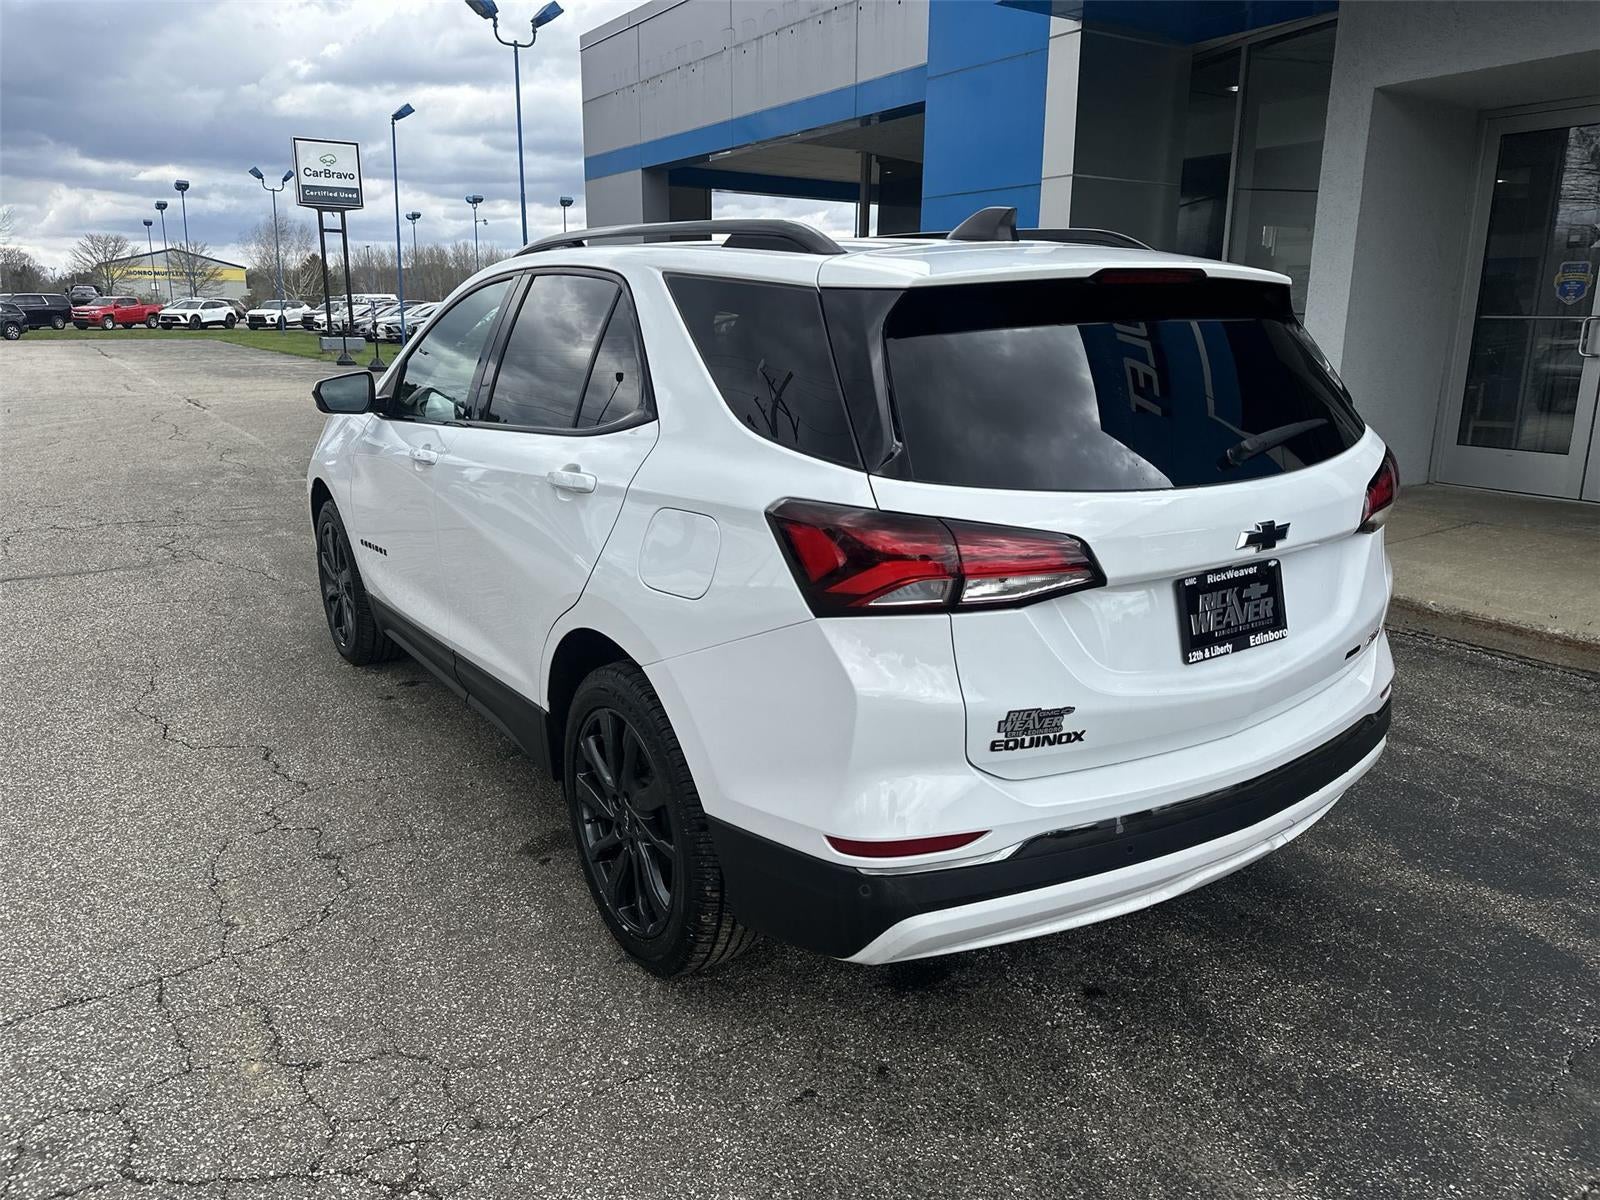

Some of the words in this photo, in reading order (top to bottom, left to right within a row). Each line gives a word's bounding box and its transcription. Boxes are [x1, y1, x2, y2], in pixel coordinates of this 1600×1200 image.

[303, 167, 355, 180] CarBravo
[305, 189, 338, 198] Certified
[1184, 577, 1198, 587] GMC
[1207, 566, 1258, 584] RickWeaver
[1200, 587, 1239, 612] RICK
[1190, 597, 1274, 636] WEAVER
[1249, 628, 1288, 647] Edinboro
[1188, 649, 1204, 663] 12th
[1204, 648, 1211, 659] &
[1210, 642, 1233, 657] Liberty
[1000, 715, 1064, 733] WEAVER
[1008, 709, 1041, 722] RICK
[1039, 709, 1061, 717] GMC
[989, 729, 1086, 752] EQUINOX
